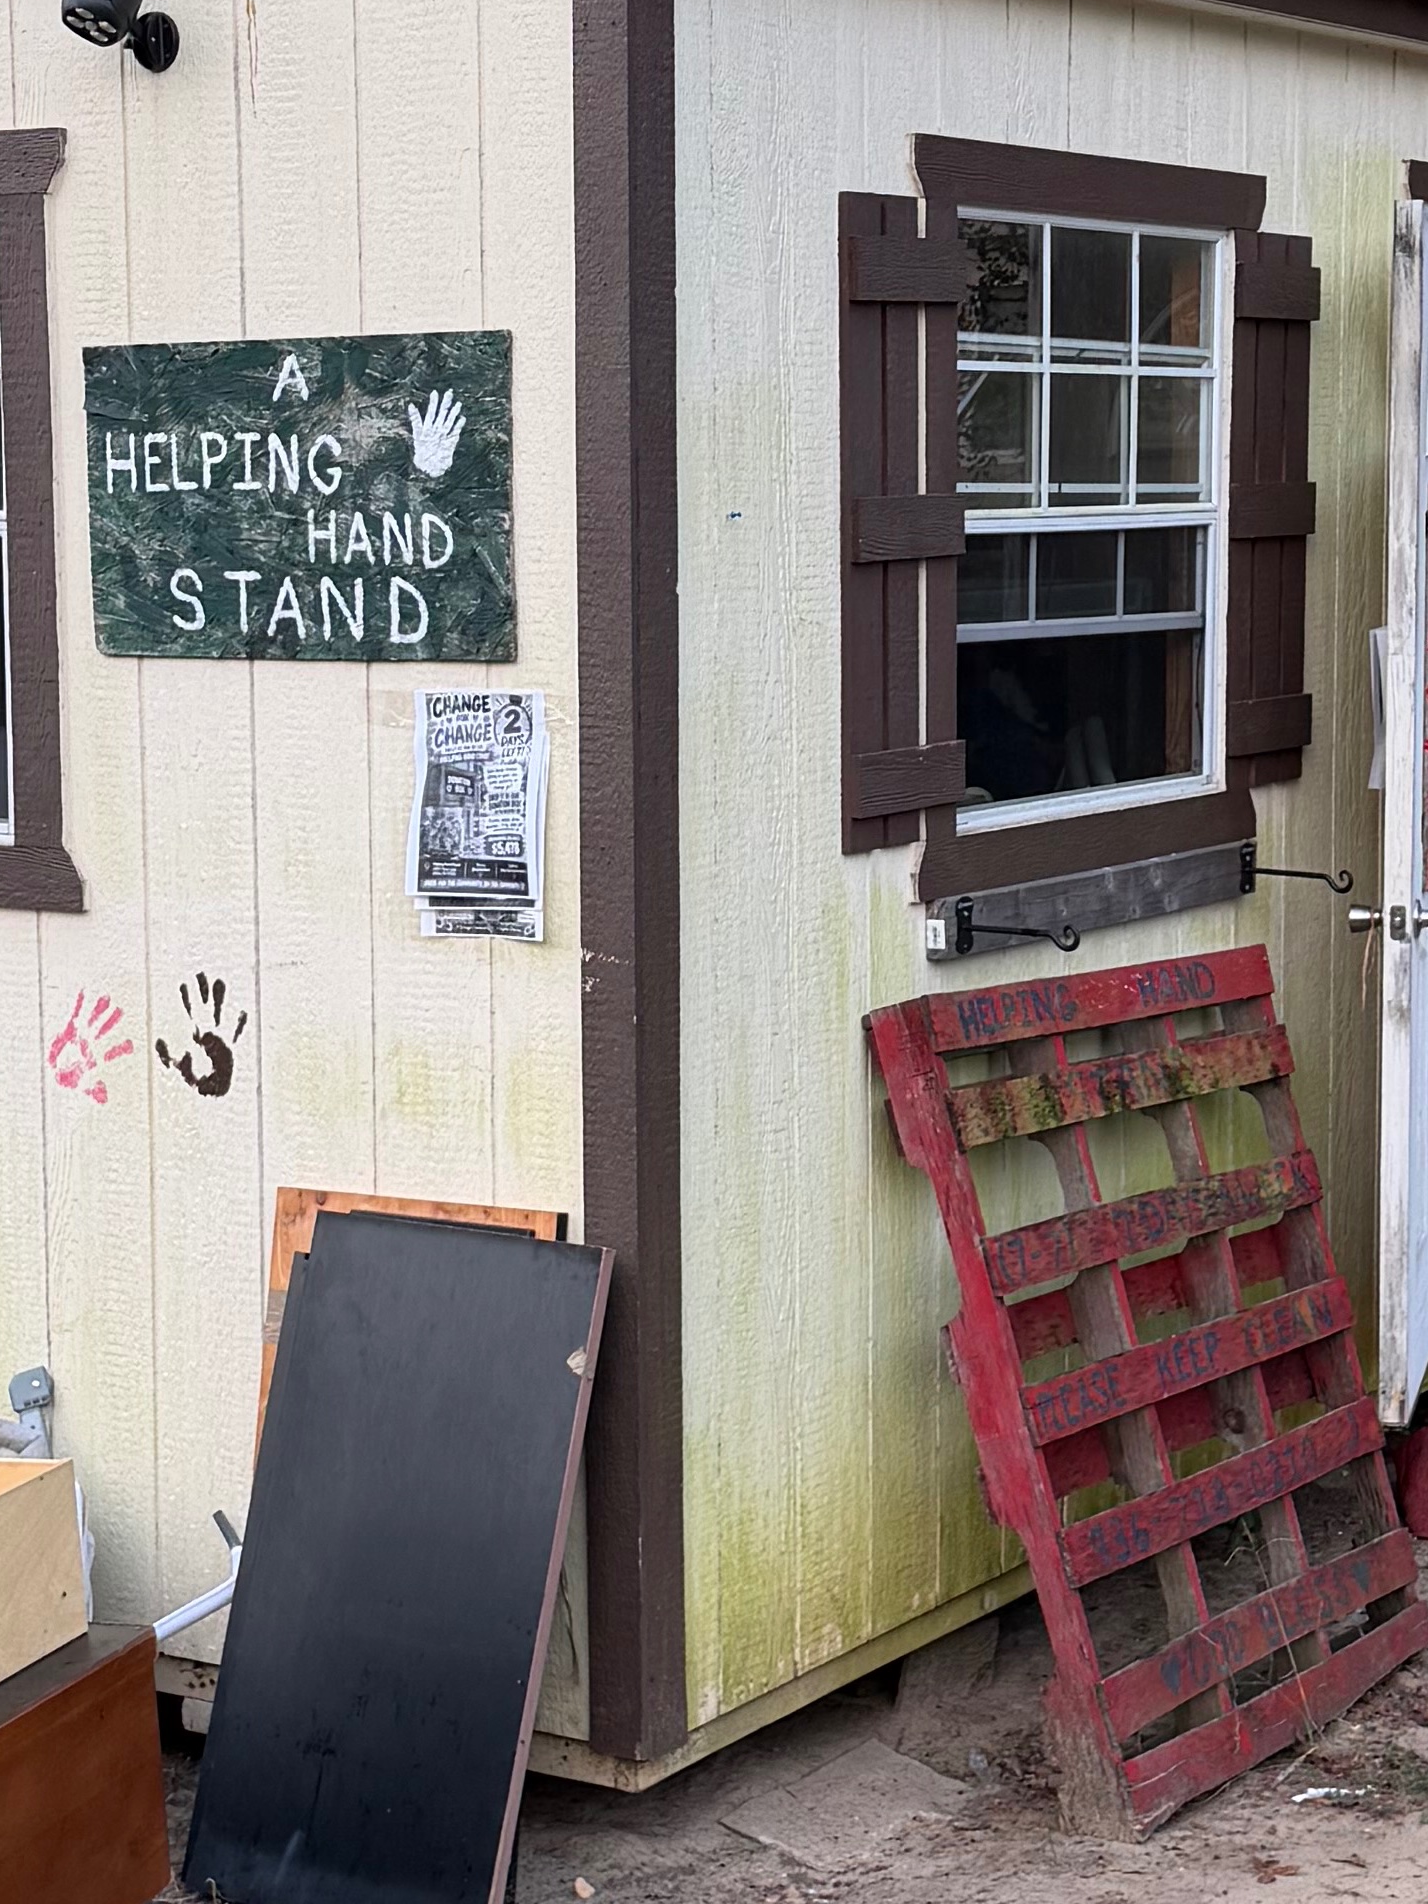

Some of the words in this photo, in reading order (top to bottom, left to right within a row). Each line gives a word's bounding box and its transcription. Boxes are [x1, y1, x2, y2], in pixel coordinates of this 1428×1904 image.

[273, 353, 310, 402] A
[105, 431, 343, 496] HELPING
[307, 508, 454, 569] HAND
[169, 568, 430, 644] STAND
[433, 694, 491, 718] CHANGE
[434, 722, 492, 749] CHANGE
[503, 708, 523, 735] 2
[957, 983, 1078, 1042] HELPING
[1136, 960, 1216, 1008] HAND
[1155, 1330, 1220, 1388] KEEP
[1243, 1293, 1334, 1358] CLEAN
